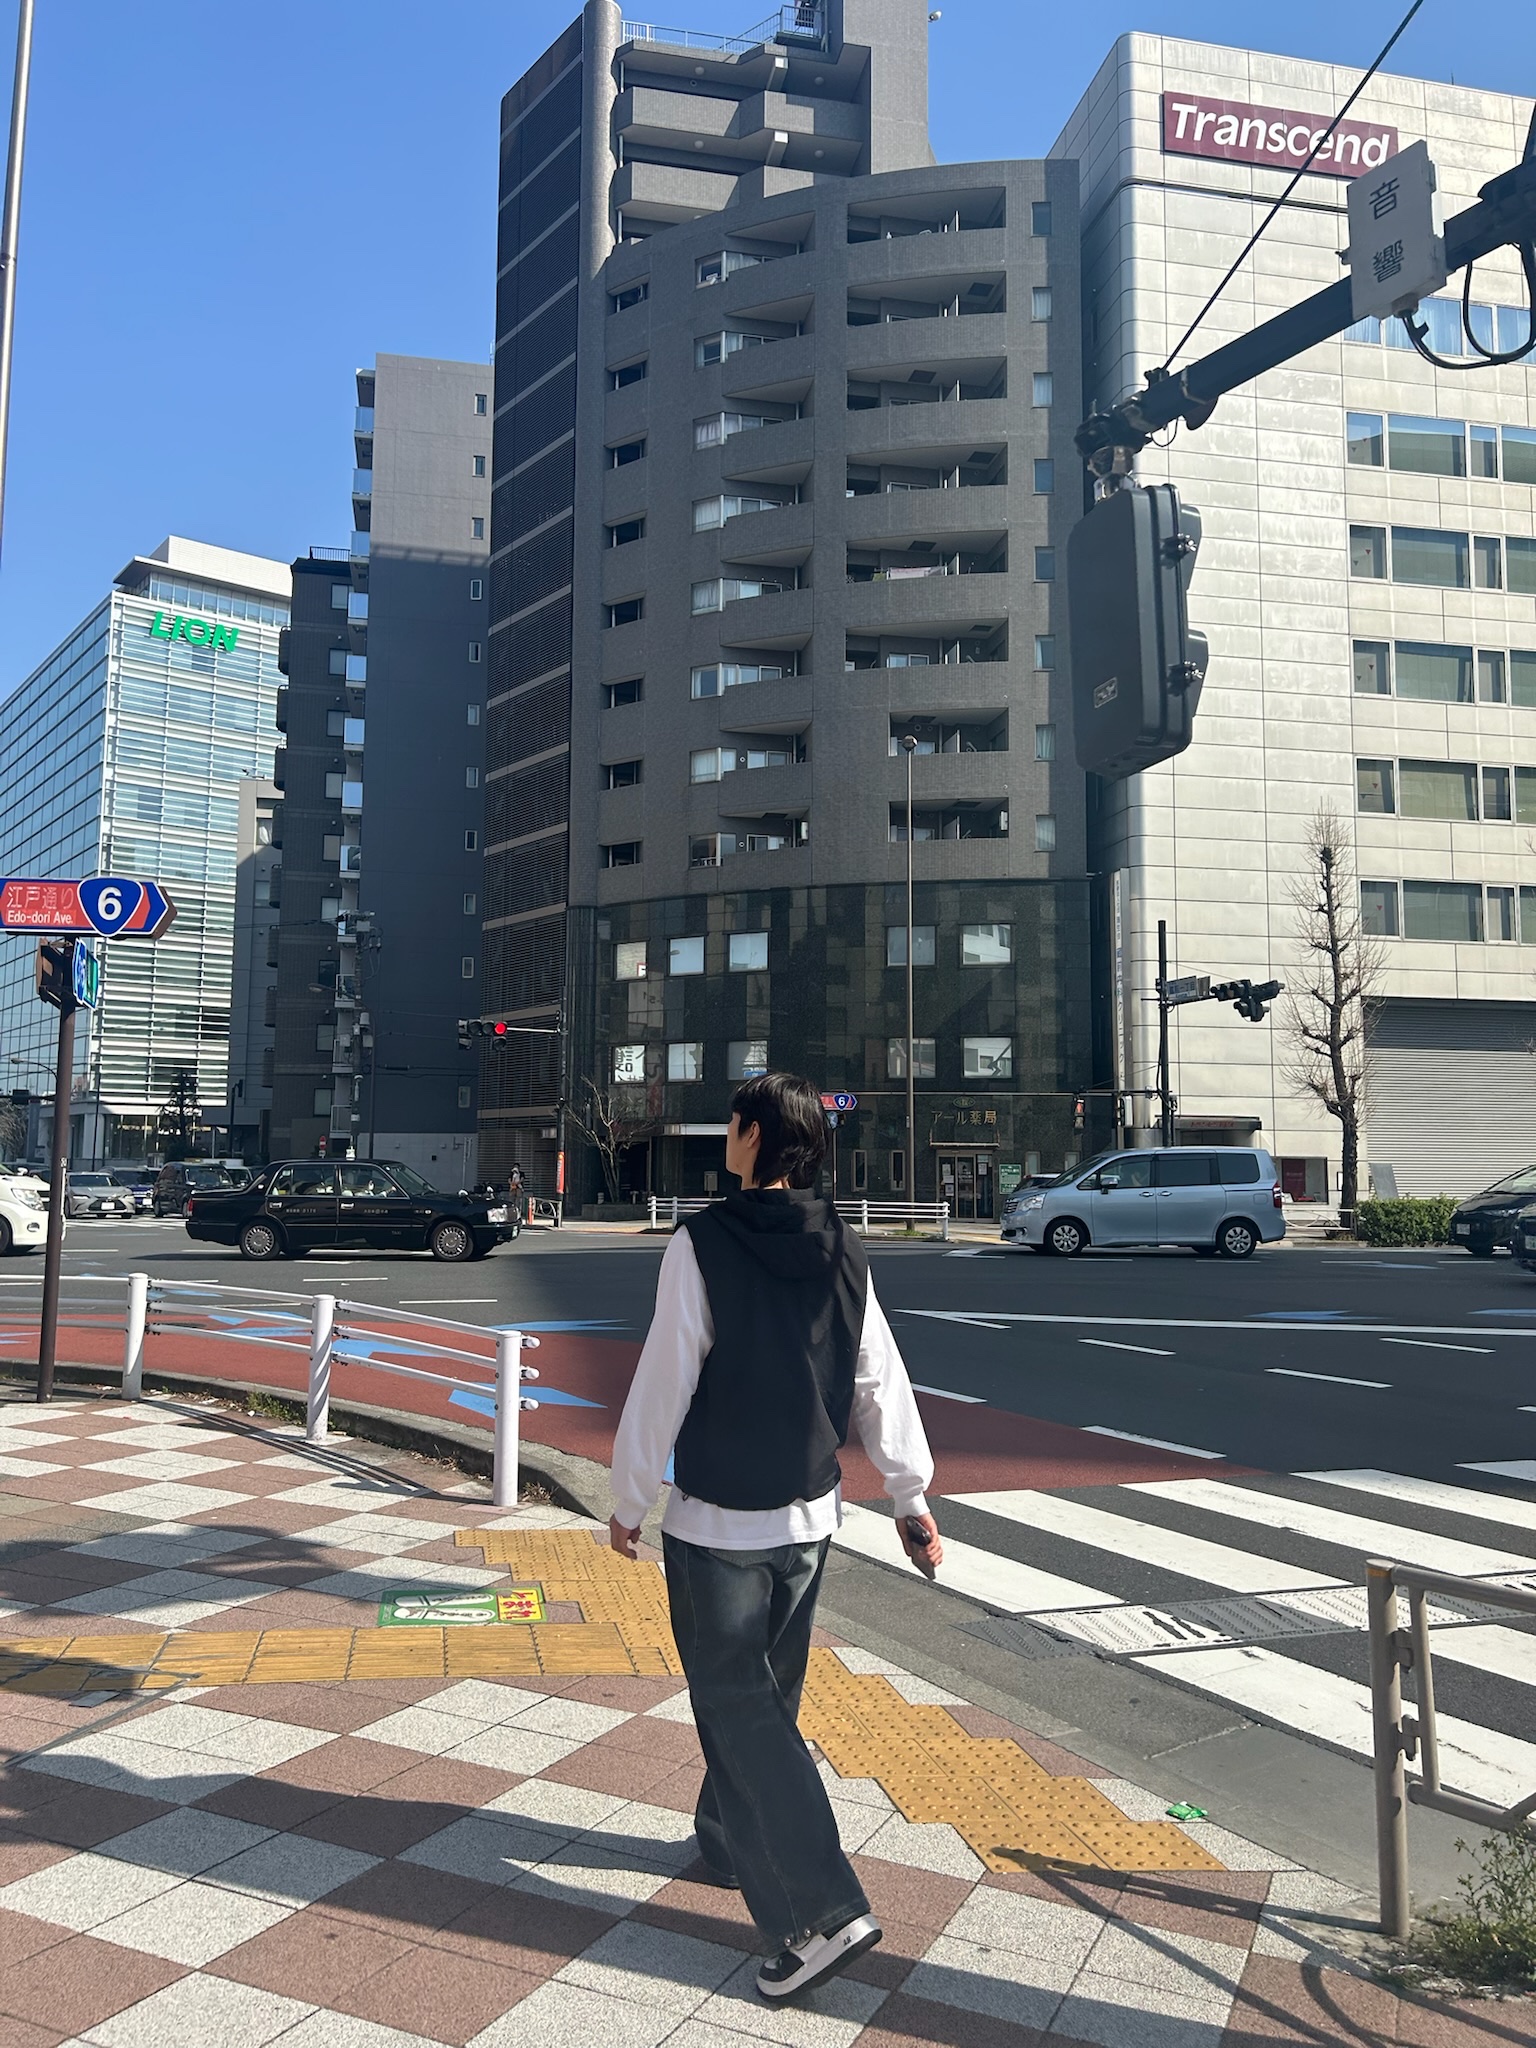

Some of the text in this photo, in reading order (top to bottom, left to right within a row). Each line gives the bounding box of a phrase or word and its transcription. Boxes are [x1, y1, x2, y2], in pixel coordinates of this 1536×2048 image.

[1172, 103, 1390, 168] Transcend
[151, 611, 239, 652] LION
[7, 886, 75, 909] 江戸通り
[97, 886, 122, 921] 6
[7, 910, 73, 924] Edo-dori Ave.
[838, 1096, 846, 1107] 6
[931, 1110, 997, 1126] アール薬局
